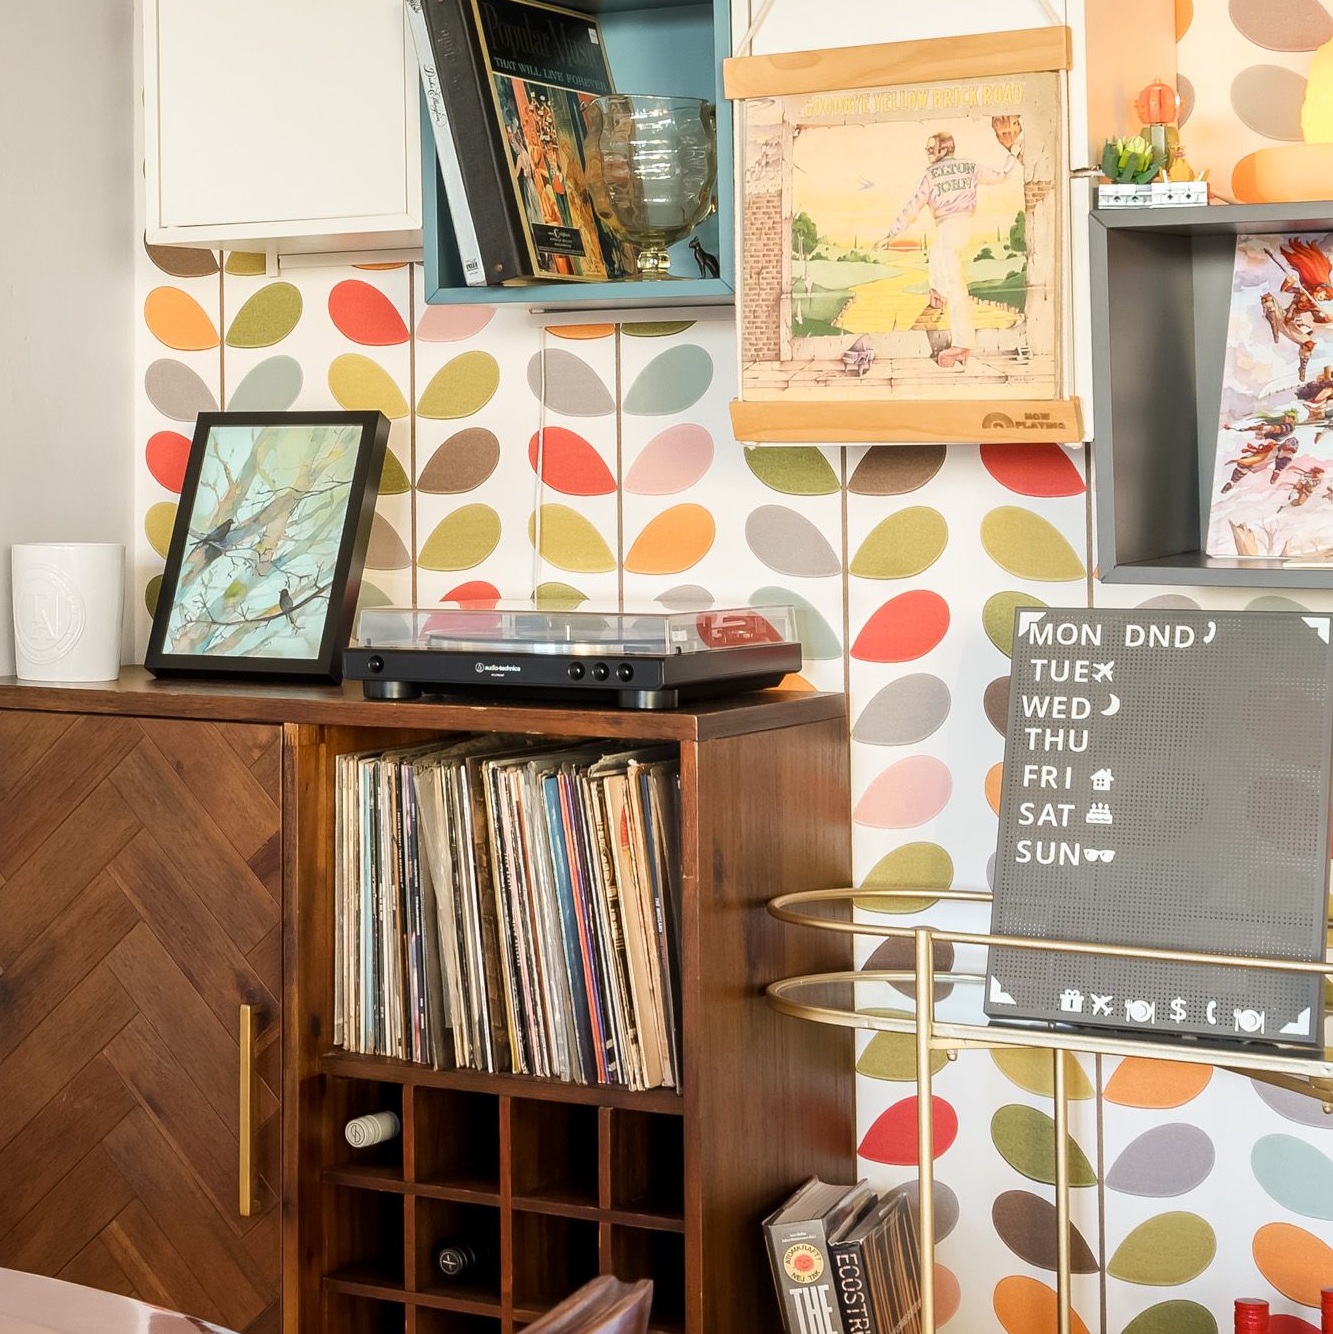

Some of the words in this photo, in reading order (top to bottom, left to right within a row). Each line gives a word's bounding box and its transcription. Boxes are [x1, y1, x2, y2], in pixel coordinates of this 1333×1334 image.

[494, 57, 518, 71] THAT
[518, 63, 542, 77] WILL
[542, 69, 564, 82] LIVE
[803, 93, 870, 116] GOODBYE
[874, 89, 928, 112] YELLOW
[932, 86, 978, 108] BRICK
[983, 83, 1024, 107] ROAD
[931, 163, 976, 178] ELTON
[934, 177, 972, 197] JOHN
[1015, 421, 1066, 429] PLAYING
[1029, 622, 1102, 646] MON
[1125, 624, 1195, 648] DND
[1030, 659, 1089, 683] TUE
[1022, 695, 1091, 720] WED
[1025, 727, 1088, 752] THU
[1023, 765, 1072, 789] FRI
[1019, 802, 1075, 827] SAT
[1016, 840, 1080, 866] SUN
[808, 1269, 821, 1281] TAK
